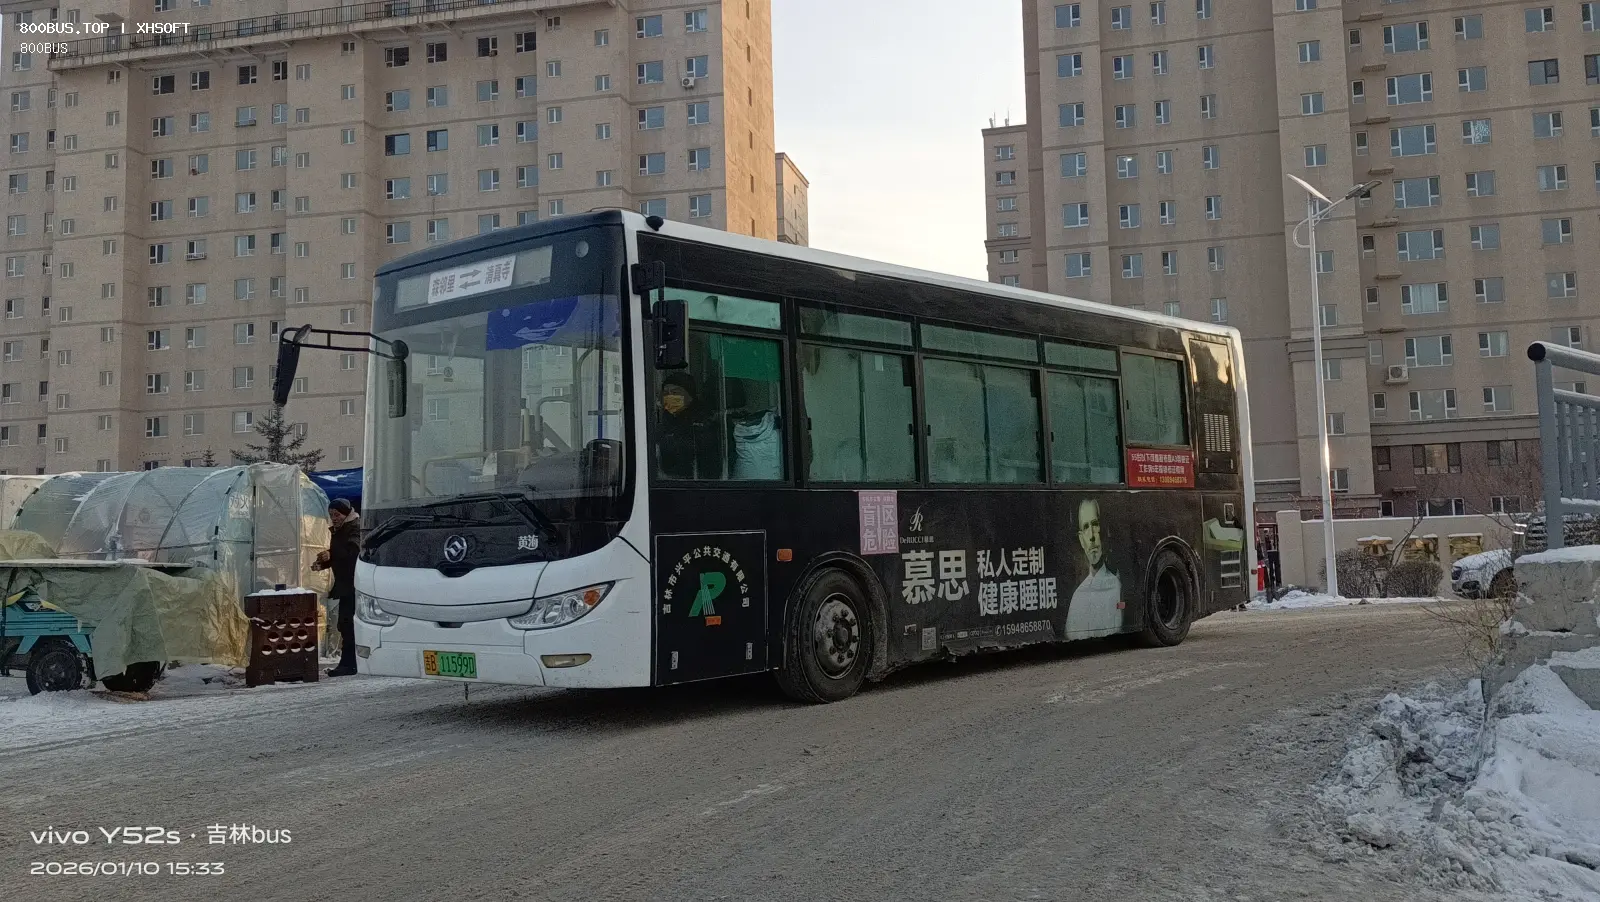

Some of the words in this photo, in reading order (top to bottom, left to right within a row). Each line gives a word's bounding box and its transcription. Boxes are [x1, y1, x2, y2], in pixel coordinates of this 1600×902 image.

[862, 503, 896, 527] 盲区
[517, 534, 539, 551] 黄海
[862, 528, 897, 551] 危险
[976, 546, 1045, 579] 私人定制
[902, 550, 970, 605] 慕思
[978, 577, 1058, 617] 健康睡眠
